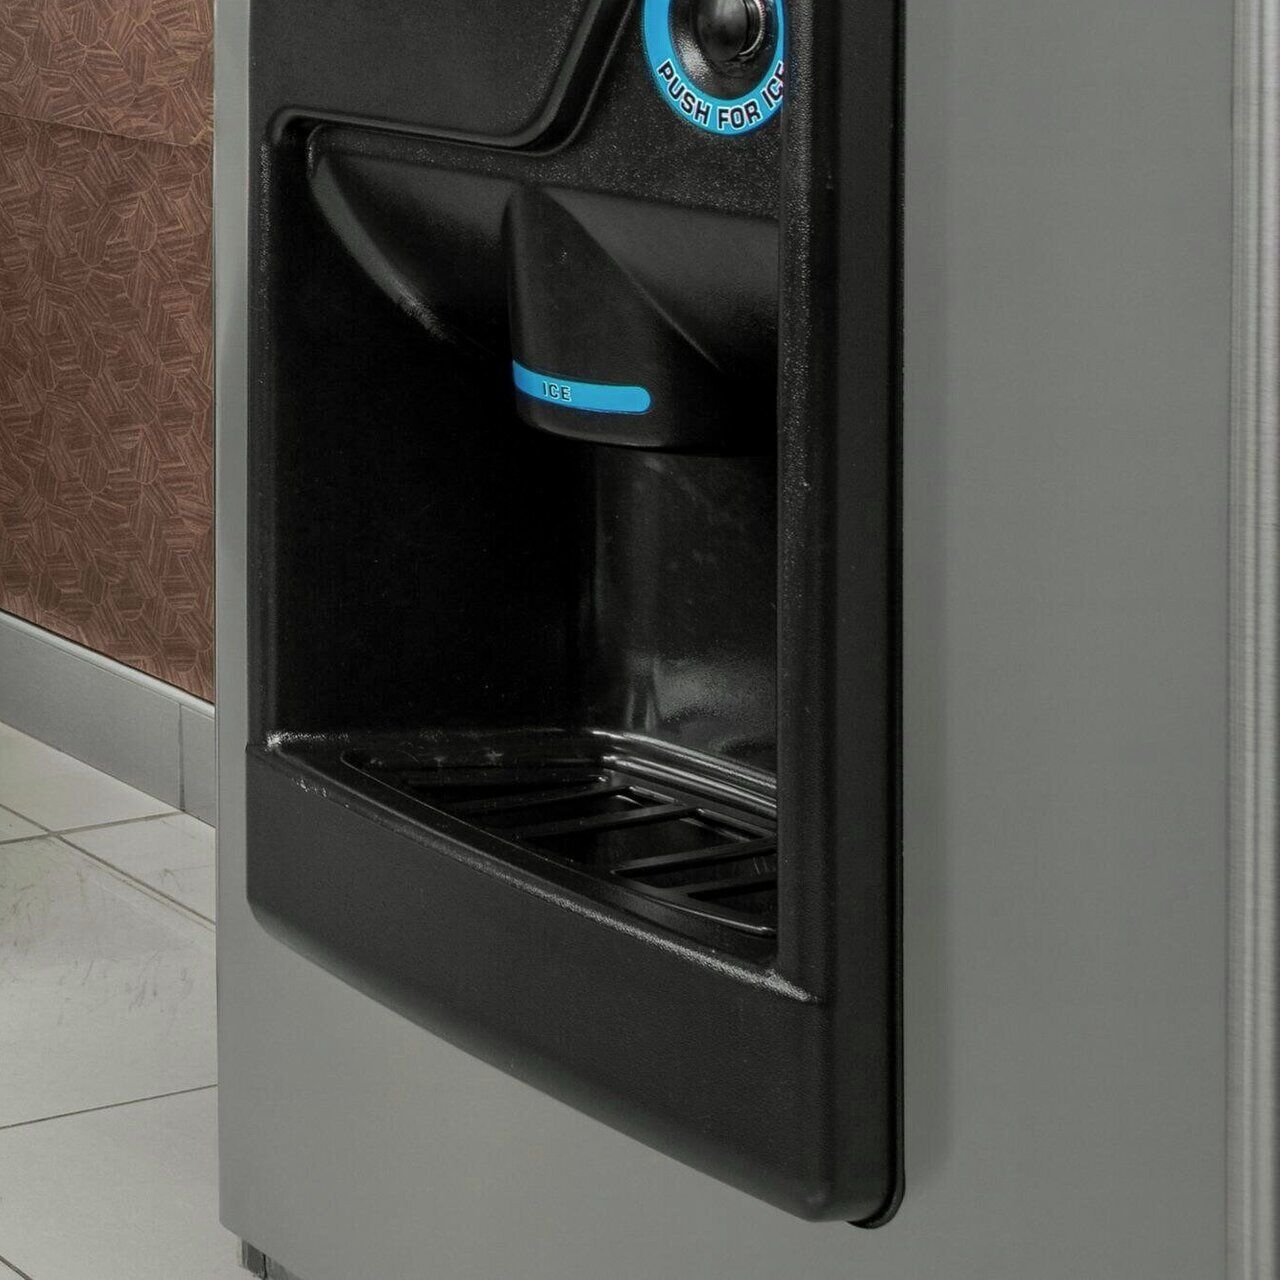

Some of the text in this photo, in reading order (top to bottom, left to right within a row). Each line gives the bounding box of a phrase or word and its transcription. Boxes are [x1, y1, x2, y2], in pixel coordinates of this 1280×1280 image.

[656, 59, 712, 127] PUSH
[716, 99, 763, 131] FOR
[542, 380, 572, 402] ICE
